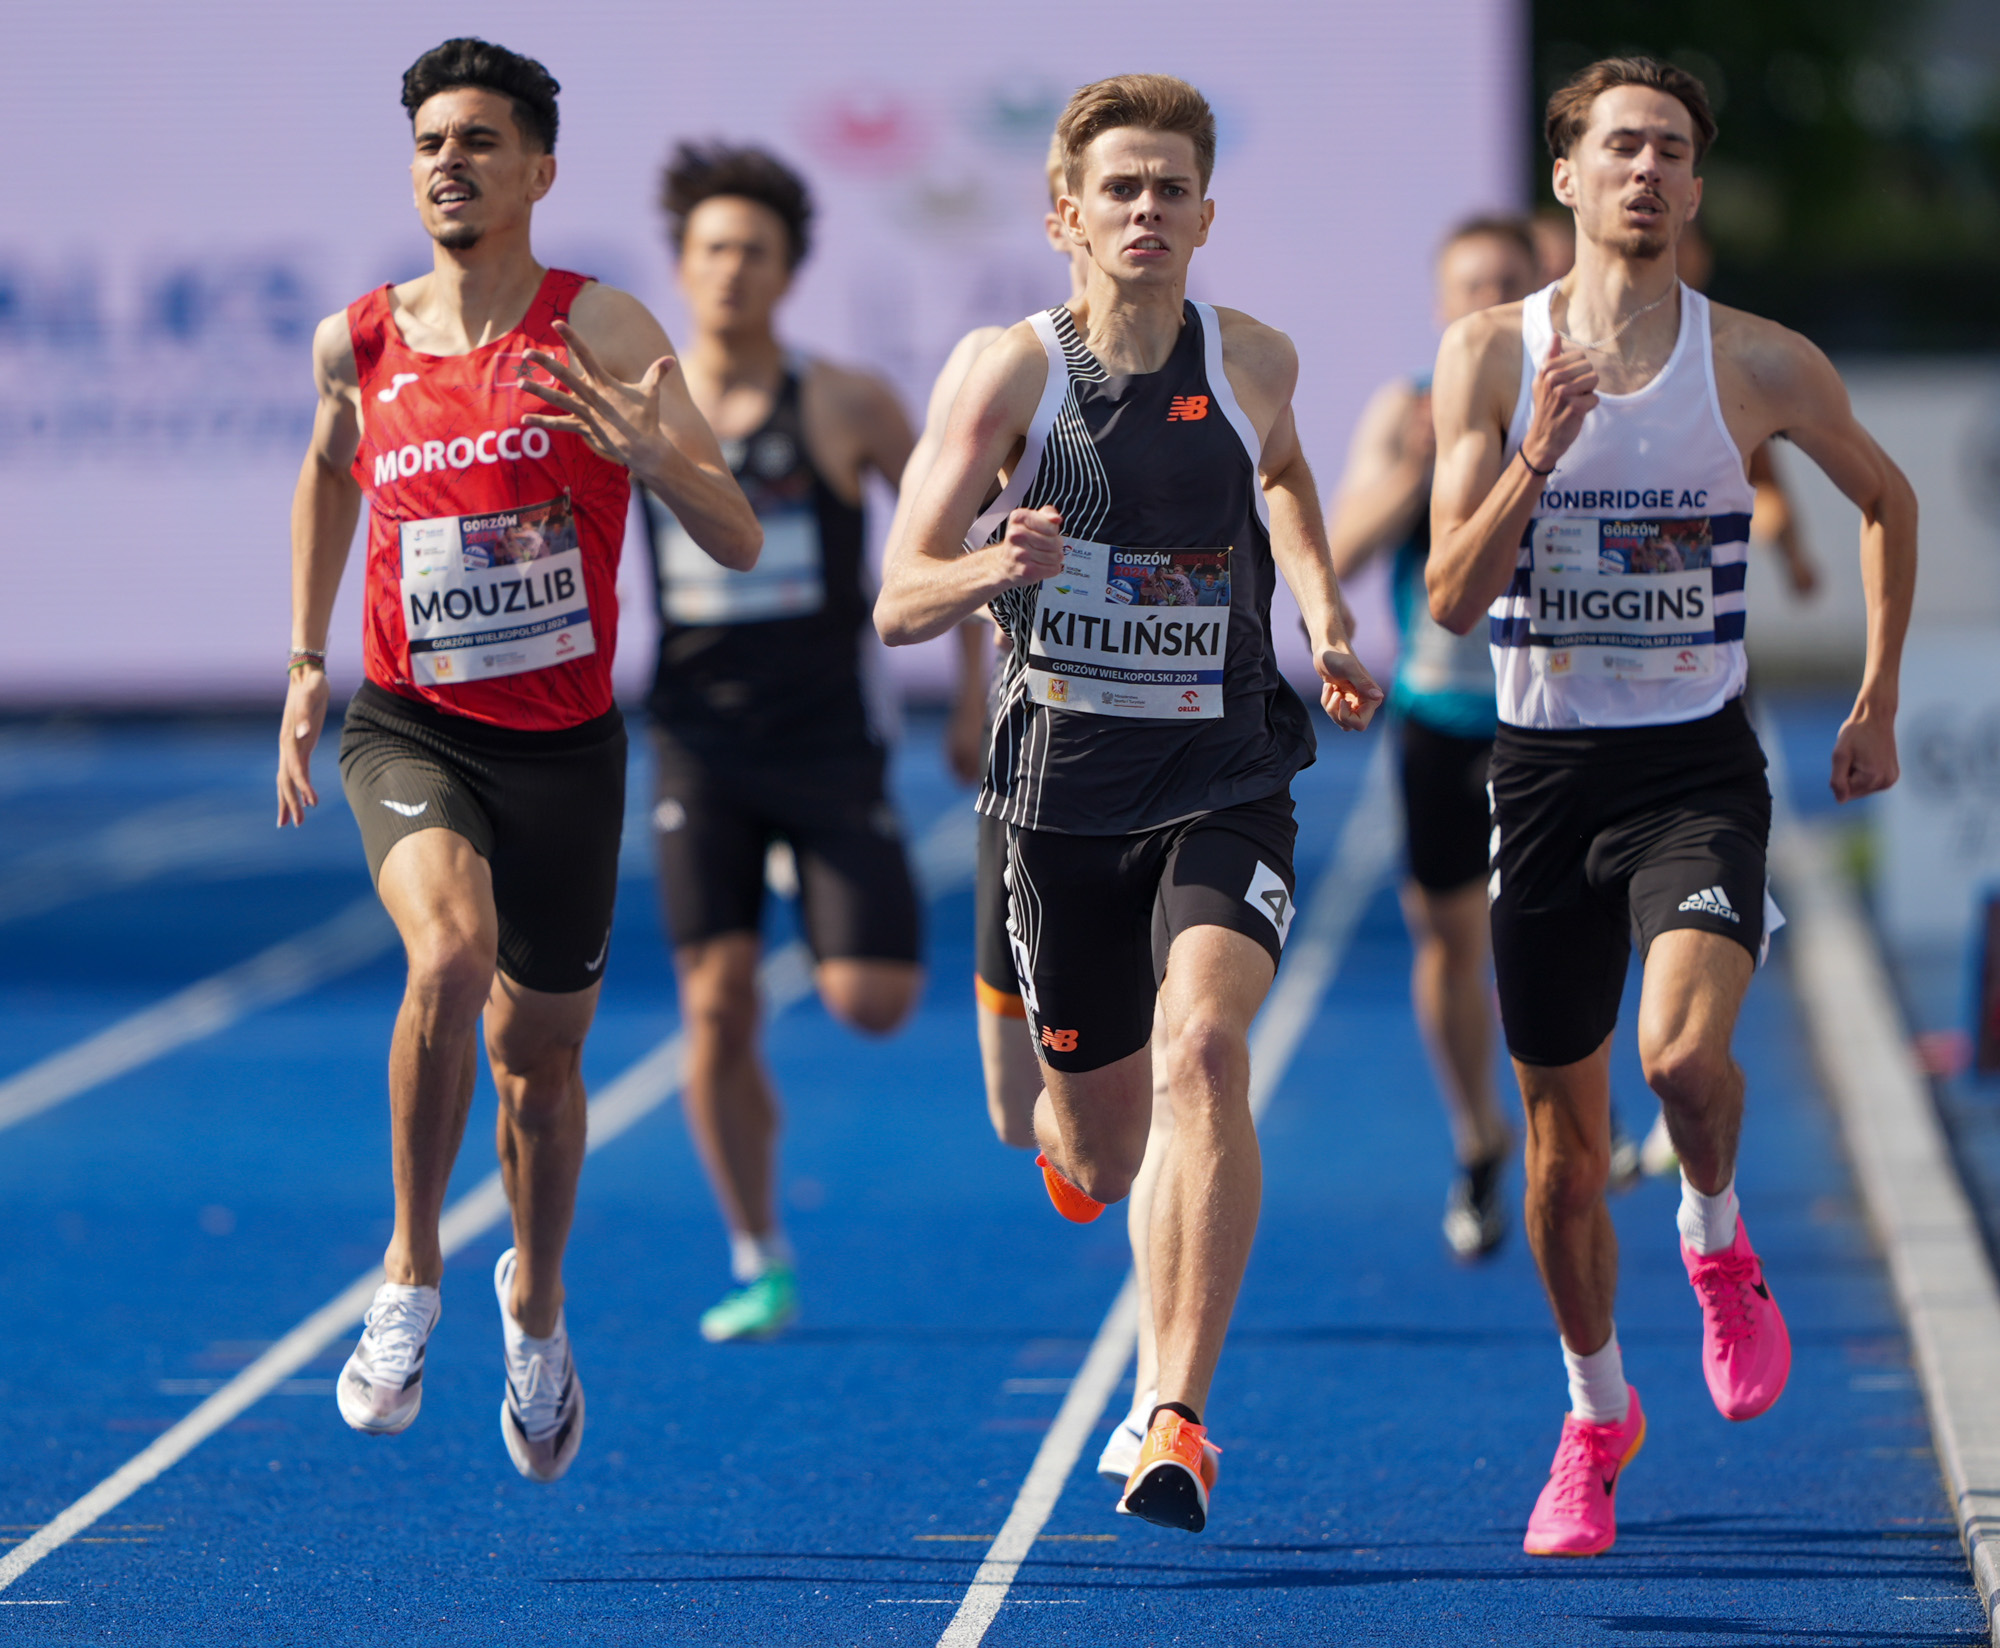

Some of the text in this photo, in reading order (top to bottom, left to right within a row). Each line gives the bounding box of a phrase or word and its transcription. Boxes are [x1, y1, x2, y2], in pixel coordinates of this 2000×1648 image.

[374, 426, 550, 487] MOROCCO
[1678, 490, 1708, 508] AC
[463, 514, 518, 532] GORZÓW
[1603, 523, 1660, 537] GORZÓW
[1113, 551, 1171, 565] GORZÓW
[1113, 566, 1149, 577] 2024
[410, 567, 576, 625] MOUZLIB
[1539, 586, 1704, 622] HIGGINS
[432, 617, 567, 650] GORZÓW WIELKOPOLSKI 2024
[1040, 608, 1220, 656] KITLIŃSKI
[1553, 633, 1693, 647] GORZÓW WIELKOPOLSKI 2024
[1052, 662, 1198, 683] GORZÓW WIELKOPOLSKI 2024
[1260, 889, 1287, 928] 4
[1678, 899, 1740, 923] adidas
